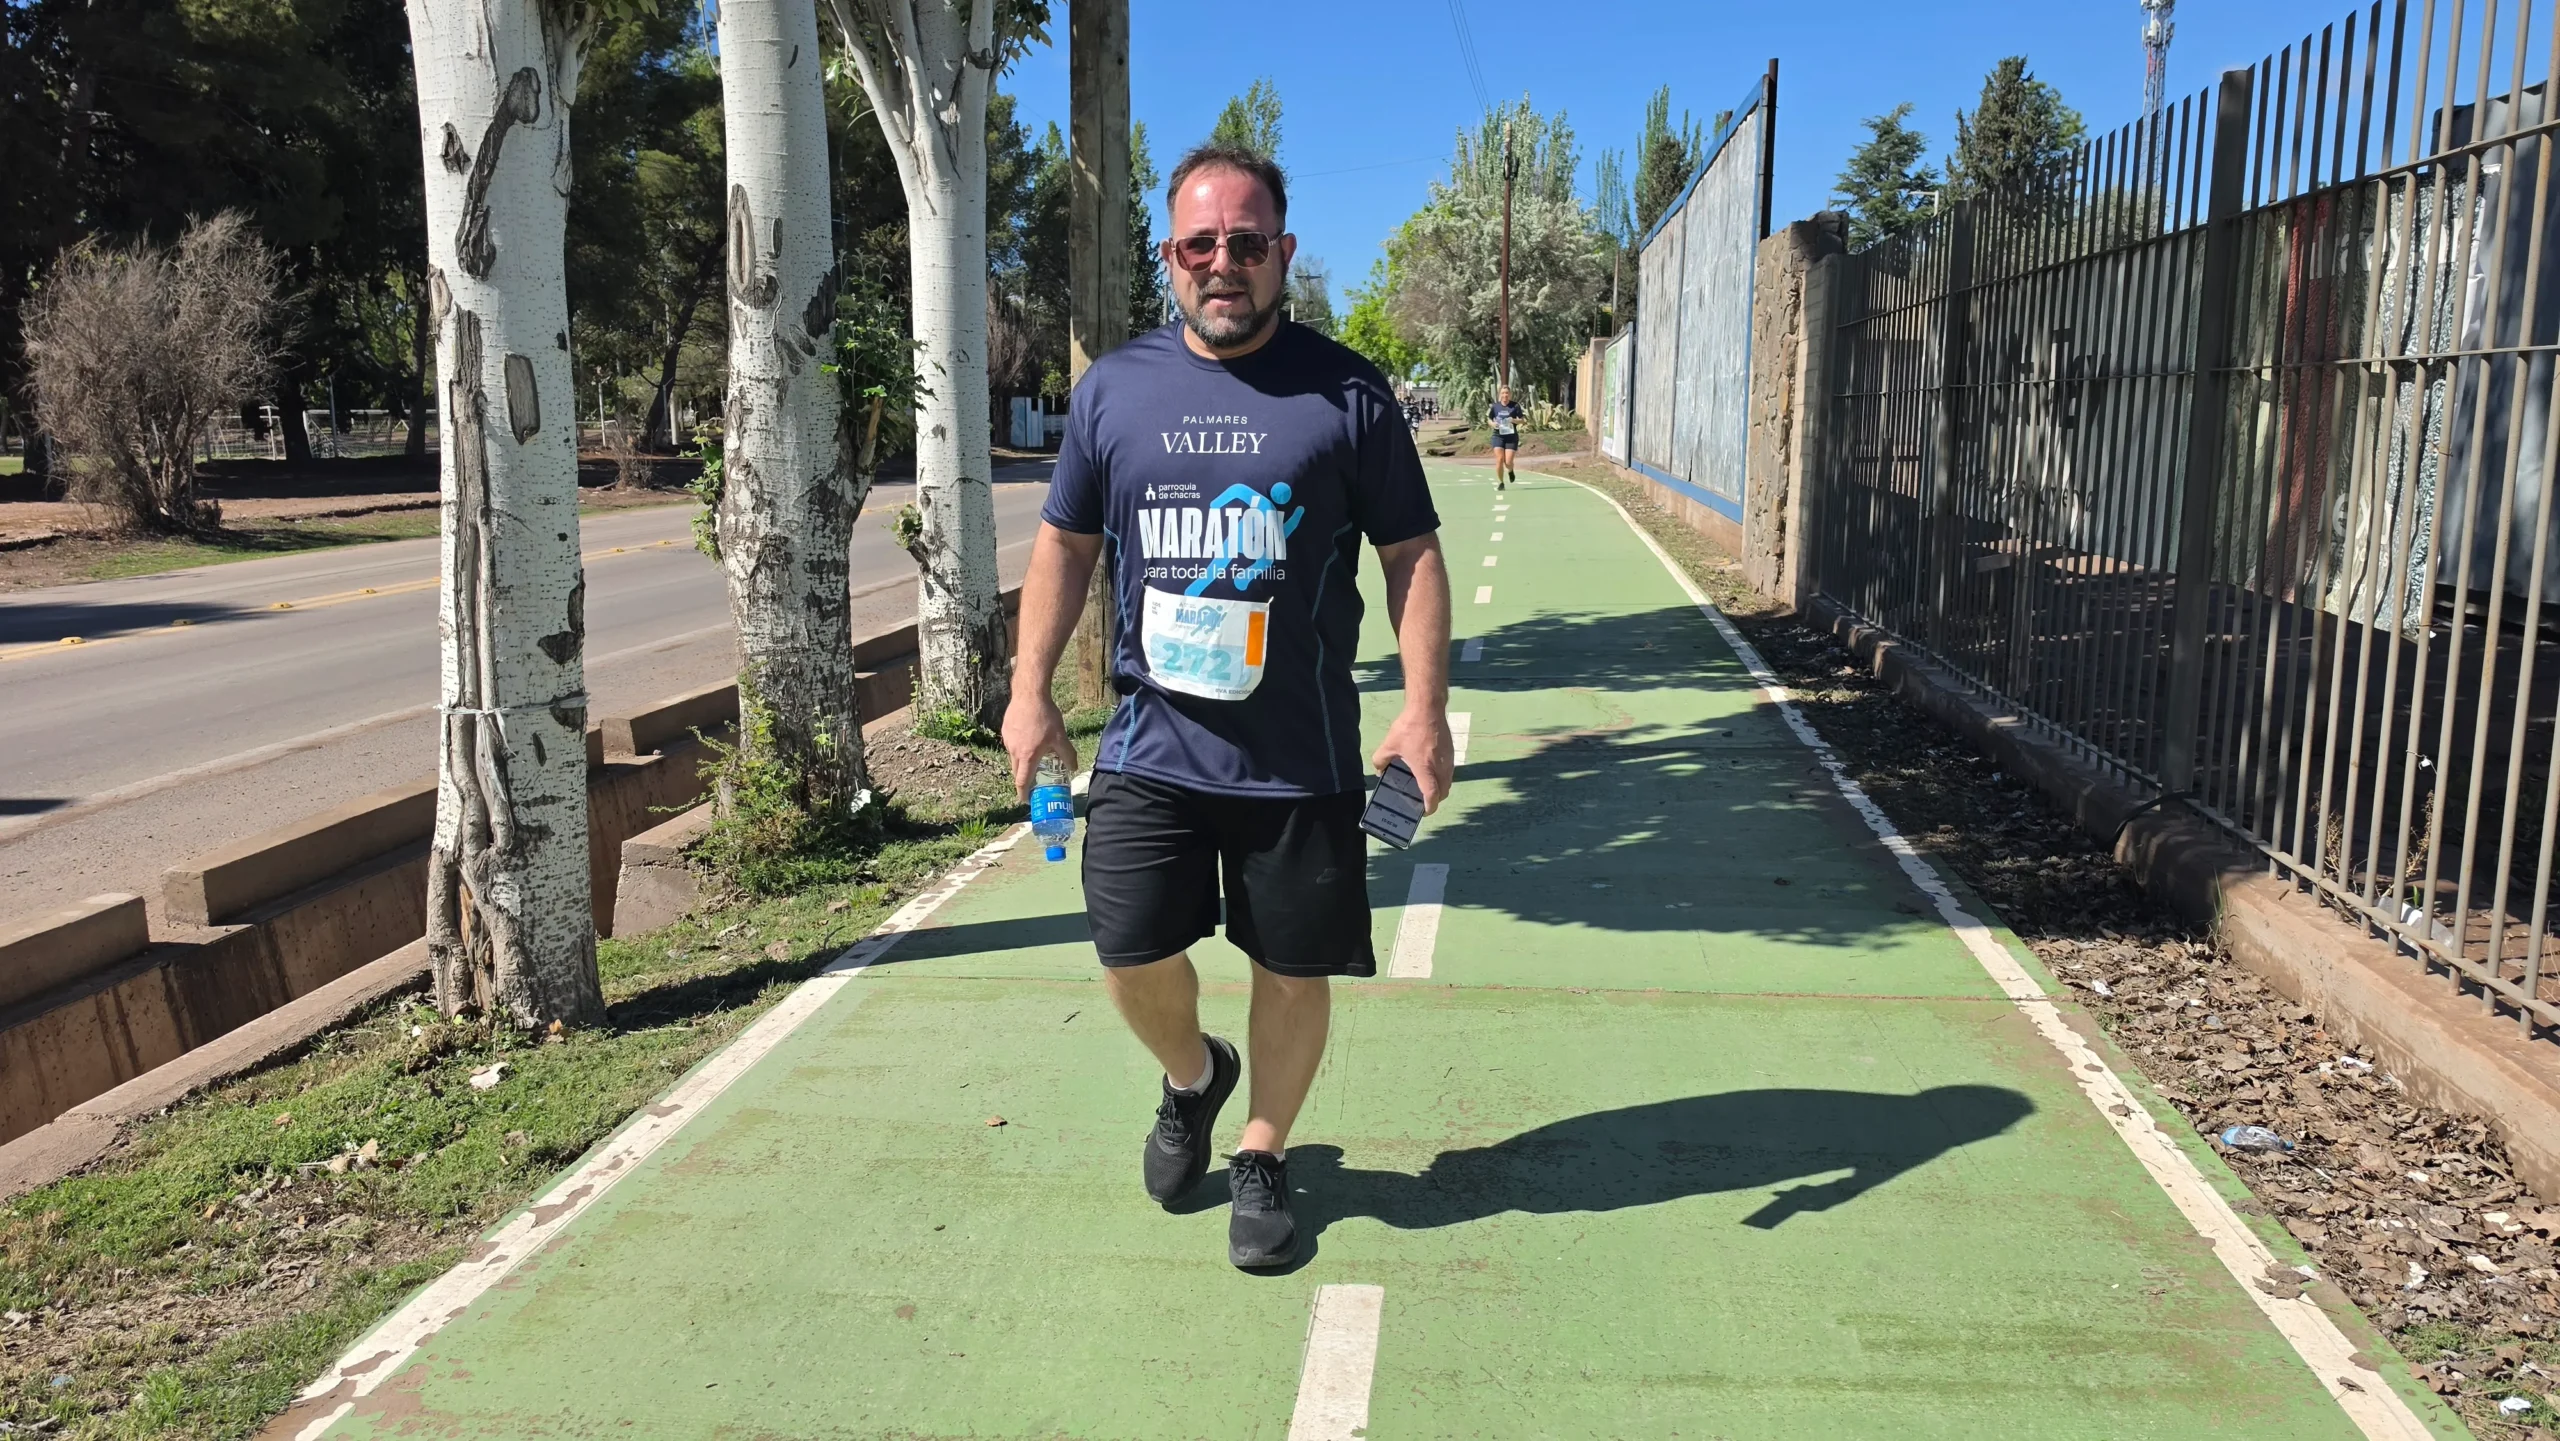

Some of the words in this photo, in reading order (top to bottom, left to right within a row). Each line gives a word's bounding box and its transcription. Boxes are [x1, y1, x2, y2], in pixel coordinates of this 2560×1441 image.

[1183, 415, 1248, 424] PALMARES
[1161, 431, 1267, 454] VALLEY
[1158, 483, 1196, 492] parroquia
[1169, 491, 1200, 499] chacras
[1138, 495, 1287, 560] MARATÓN
[1171, 564, 1208, 579] toda
[1213, 565, 1226, 579] la
[1230, 564, 1286, 580] familia
[1163, 642, 1232, 680] 272
